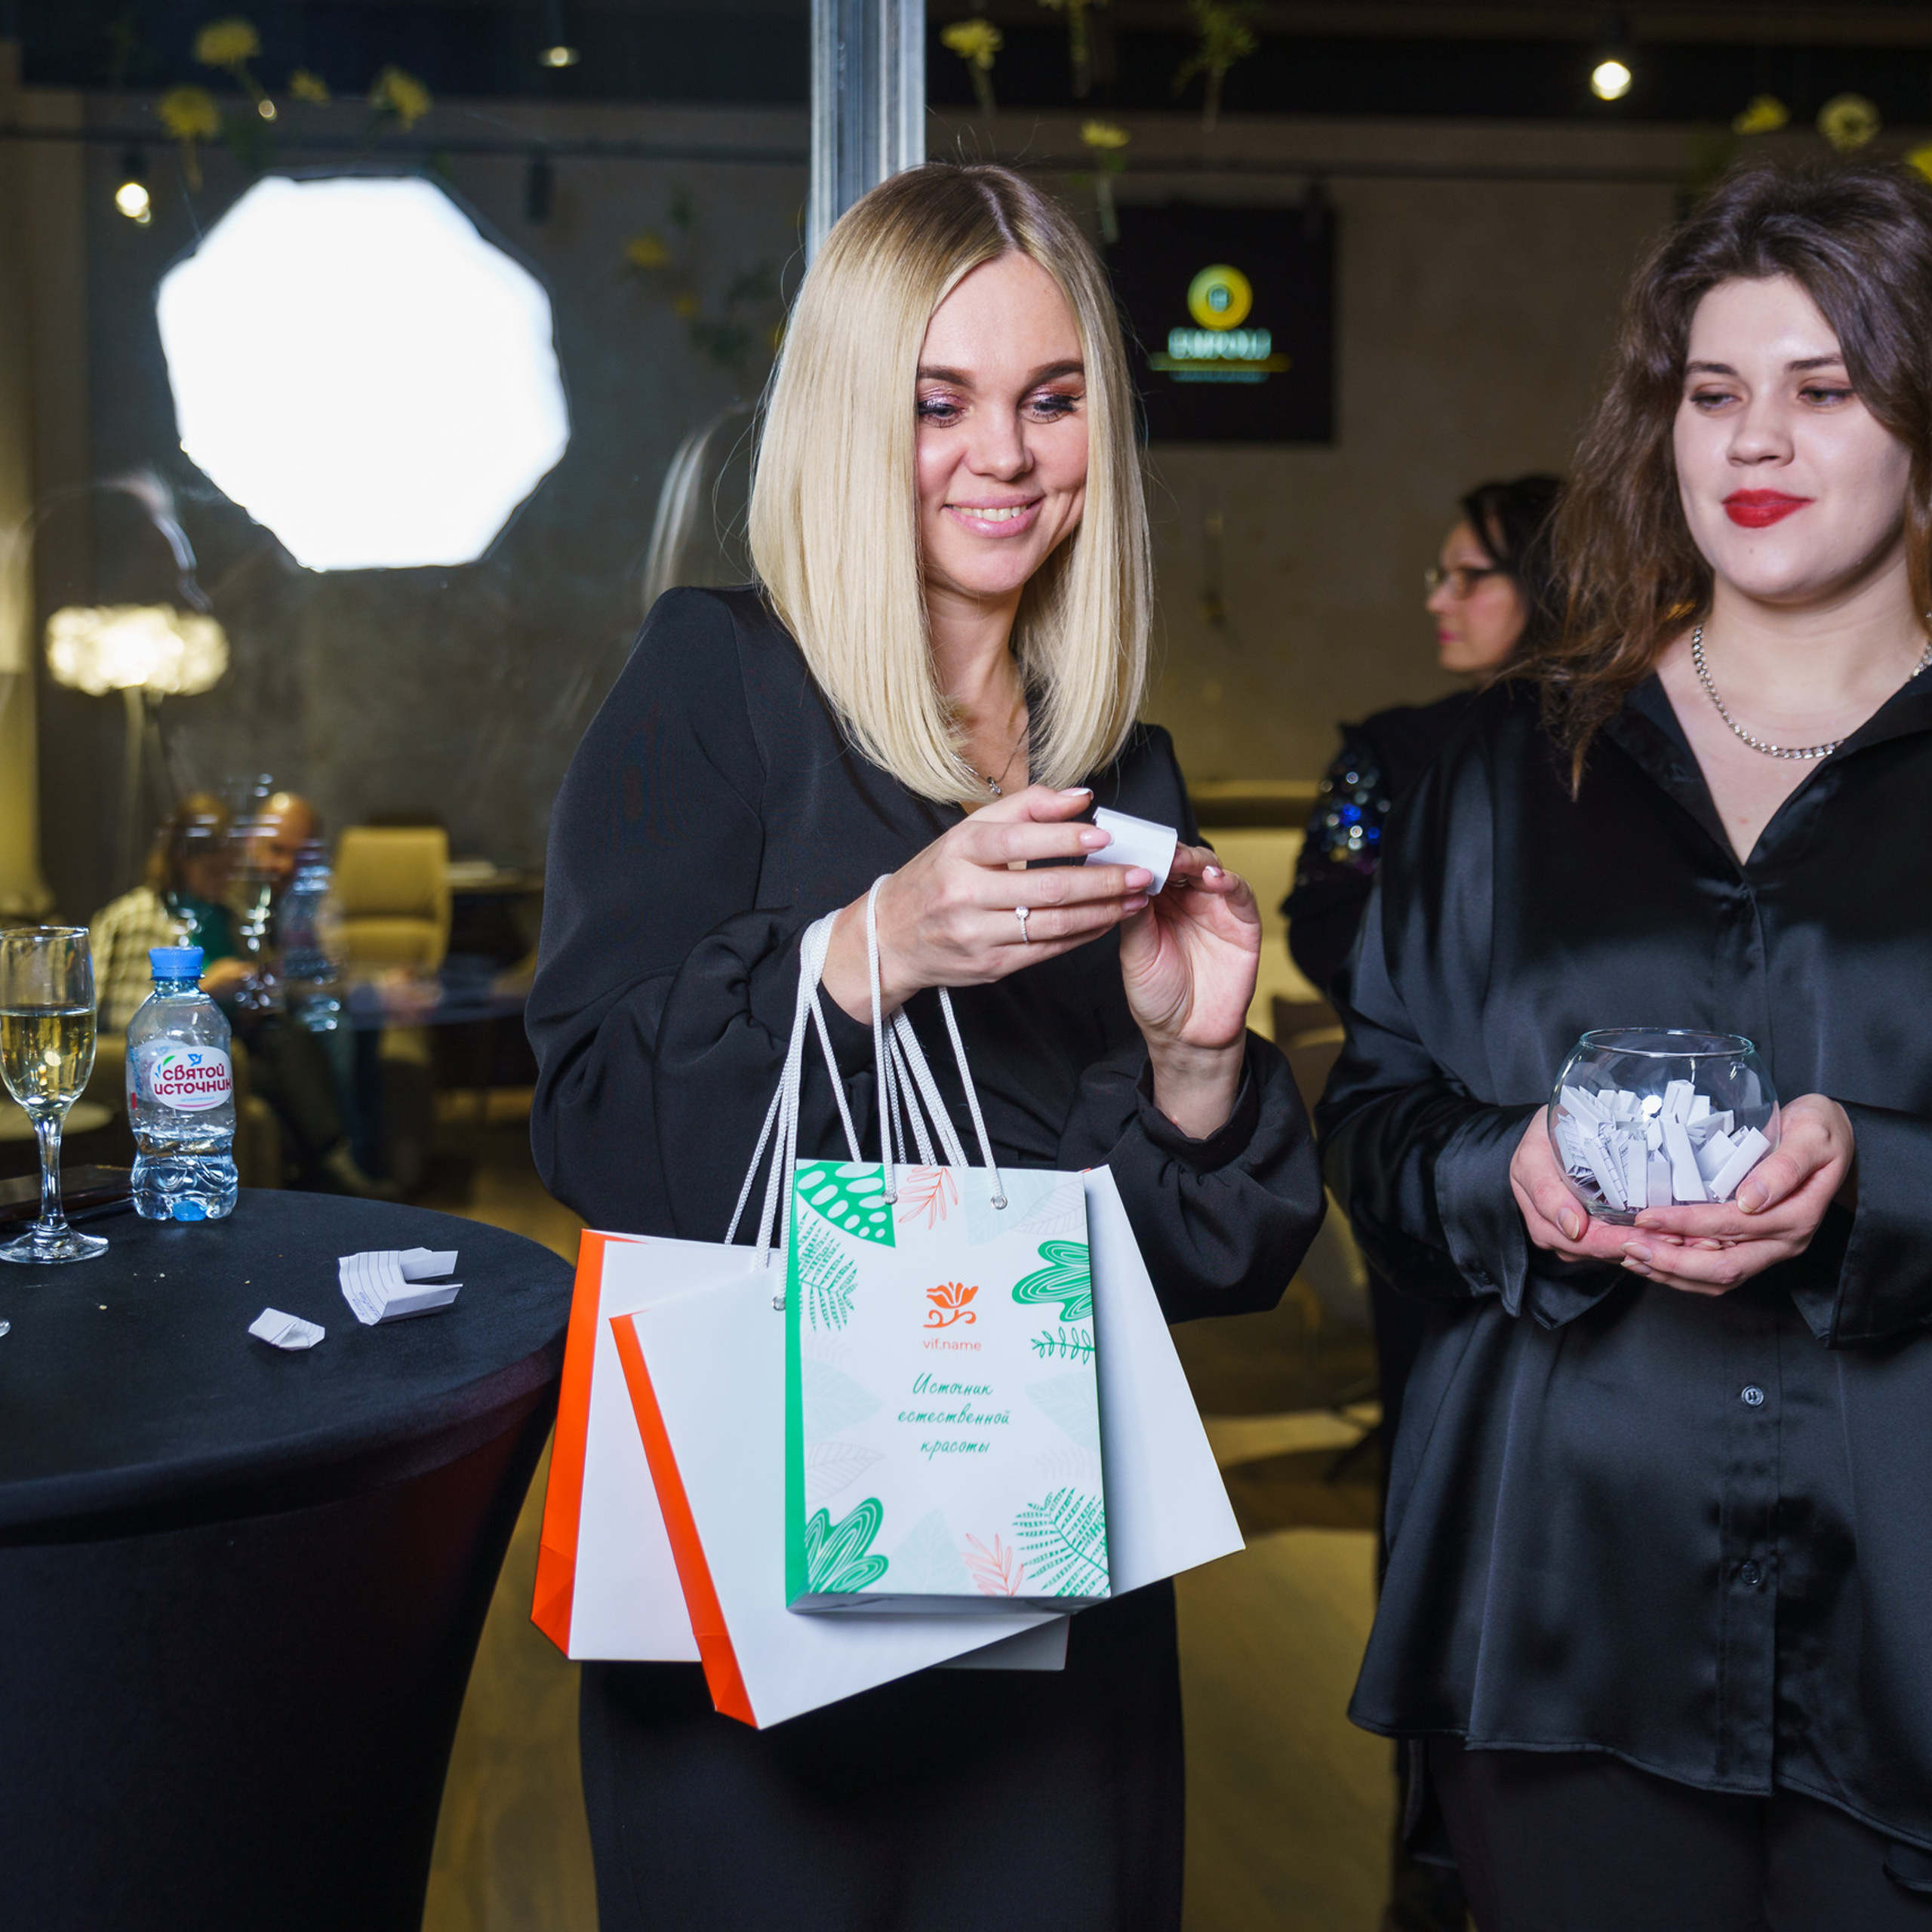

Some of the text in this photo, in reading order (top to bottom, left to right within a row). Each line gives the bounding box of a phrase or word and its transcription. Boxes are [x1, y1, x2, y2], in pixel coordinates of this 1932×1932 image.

[923, 1337, 982, 1351] vif.name
[912, 1372, 994, 1395] Источник
[897, 1402, 1011, 1425] естественной
[920, 1439, 991, 1462] красоты
